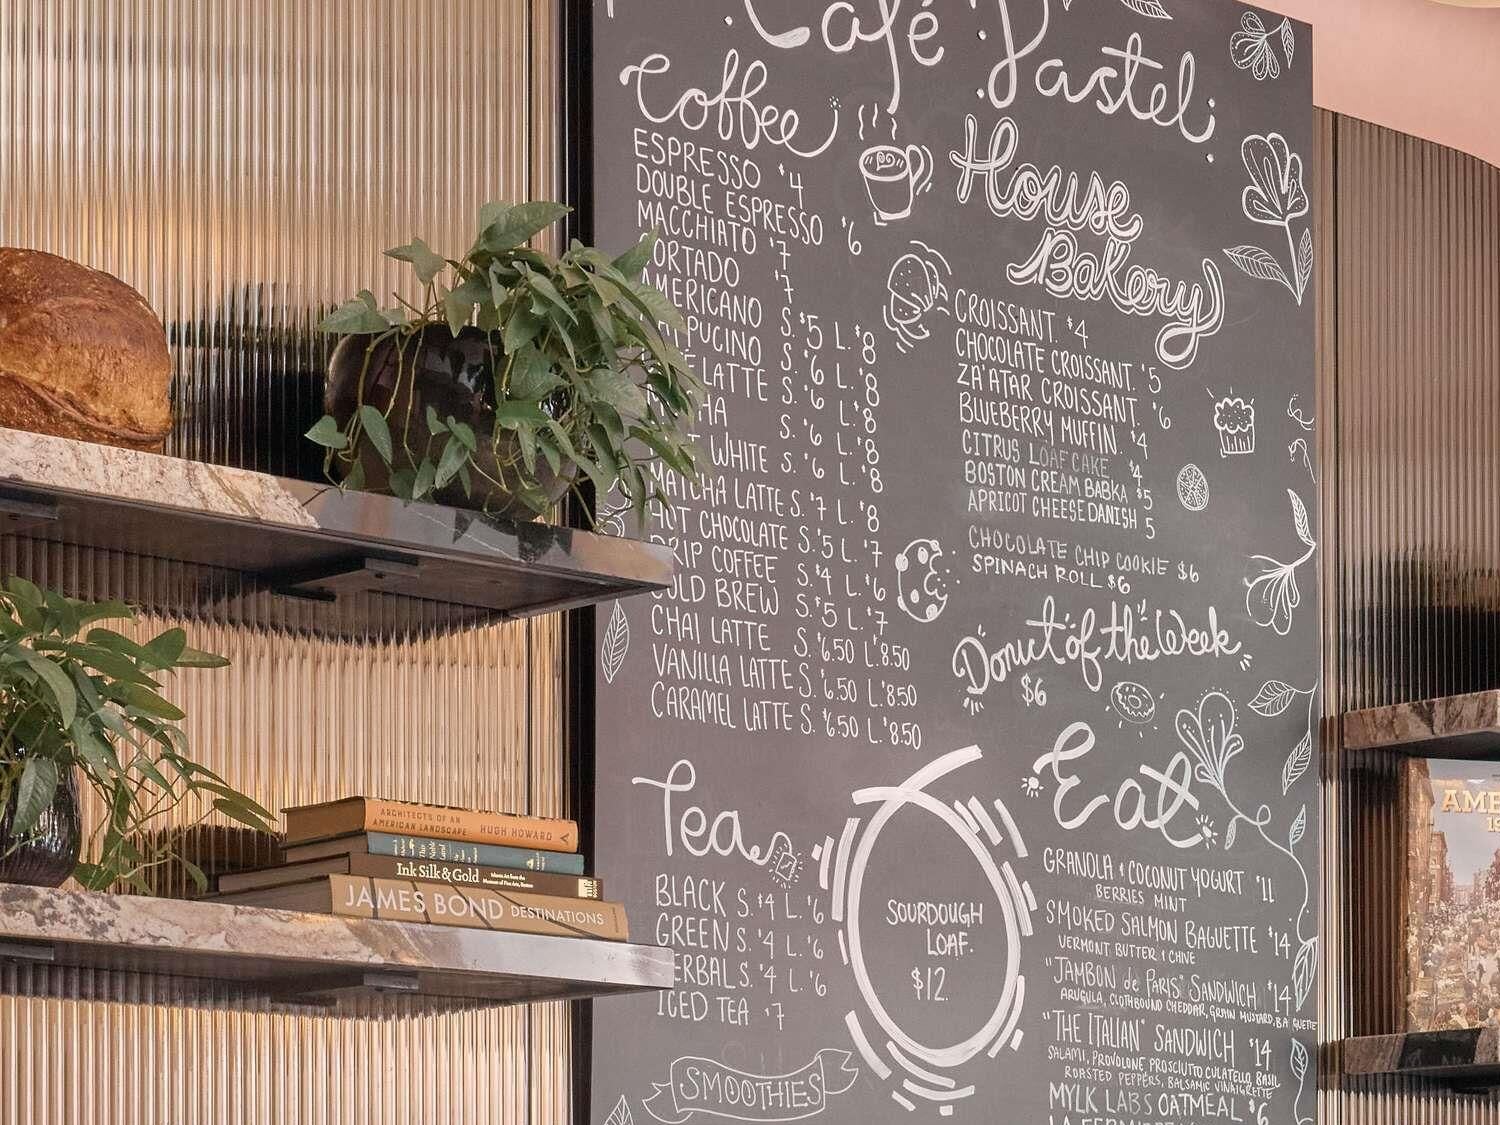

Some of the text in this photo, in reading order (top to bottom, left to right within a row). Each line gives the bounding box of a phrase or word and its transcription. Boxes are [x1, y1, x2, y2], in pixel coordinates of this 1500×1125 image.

[619, 48, 838, 158] Coffee
[634, 127, 760, 189] ESPRESSO
[949, 113, 1143, 243] House
[637, 163, 823, 245] DOUBLE ESPRESSO
[639, 199, 758, 255] MACCHIATO
[1006, 227, 1225, 370] Bakery
[781, 306, 797, 339] S.
[835, 320, 852, 351] L.
[955, 327, 1045, 375] CHOCOLATE
[1066, 315, 1089, 351] $4
[703, 357, 768, 402] LATTE
[959, 391, 1055, 447] BLUEBERRY
[710, 431, 768, 473] WHITE
[961, 429, 1021, 473] CITRUS
[1029, 441, 1069, 475] LOAF
[1071, 452, 1109, 480] CAKE
[735, 478, 785, 517] LATTE
[965, 459, 1154, 511] BOSTON CREAM BABKA $5
[651, 498, 789, 551] HOT CHOCOLATE
[967, 488, 1156, 540] APRICOT CHEESE DANISH 5
[711, 545, 779, 585] COFFEE
[968, 525, 1201, 584] CHOCOLATE CHIP COOKIE $6
[971, 553, 1132, 596] SPINACH ROLL $6
[715, 578, 779, 616] BREW
[651, 604, 772, 652] CHAI LATTE
[952, 595, 1067, 695] Donut
[653, 643, 795, 691] VANILLA LATTE
[651, 681, 737, 730] CARAMEL
[743, 697, 795, 732] LATTE
[800, 703, 816, 736] S.
[1020, 673, 1047, 707] $6
[1032, 721, 1203, 849] Eat
[372, 818, 467, 836] AMERICAN LANDSCAPE
[380, 807, 461, 824] ARCHITECTS OF AN
[480, 823, 553, 842] HUGH HOWARD
[632, 758, 772, 868] Tea
[396, 861, 417, 877] Ink
[418, 863, 441, 881] Silk
[441, 867, 453, 883] &
[452, 867, 480, 883] Gold
[1043, 847, 1114, 882] GRANOLA
[1128, 860, 1188, 892] COCONUT
[1190, 868, 1245, 898] YOGURT
[345, 884, 426, 914] JAMES
[435, 893, 503, 921] BOND
[510, 904, 605, 925] DESTINATIONS
[655, 873, 727, 918] BLACK
[737, 887, 754, 918] S.
[785, 892, 803, 919] L.
[886, 898, 983, 928] SOURDOUGH
[1094, 883, 1188, 914] BERRIES MINT
[655, 912, 730, 953] GREEN
[1046, 899, 1292, 960] SMOKED SALMON BAGUETTE $14
[1058, 935, 1196, 966] VERMONT BUTTER CHIVE
[656, 989, 750, 1026] ICED TEA
[1109, 993, 1163, 1012] CLOTHBOUND
[1123, 966, 1292, 1017] de SANDWICH $14
[1092, 1050, 1145, 1071] PROVOLONE
[1154, 1024, 1236, 1068] SANDWICH
[1249, 1037, 1273, 1071] $14
[680, 1066, 823, 1110] SMOOTHIES
[1064, 1066, 1113, 1083] ROASTED
[1049, 1081, 1099, 1115] MYLK
[1105, 1087, 1153, 1116] LABS
[1157, 1092, 1243, 1123] OATMEAL
